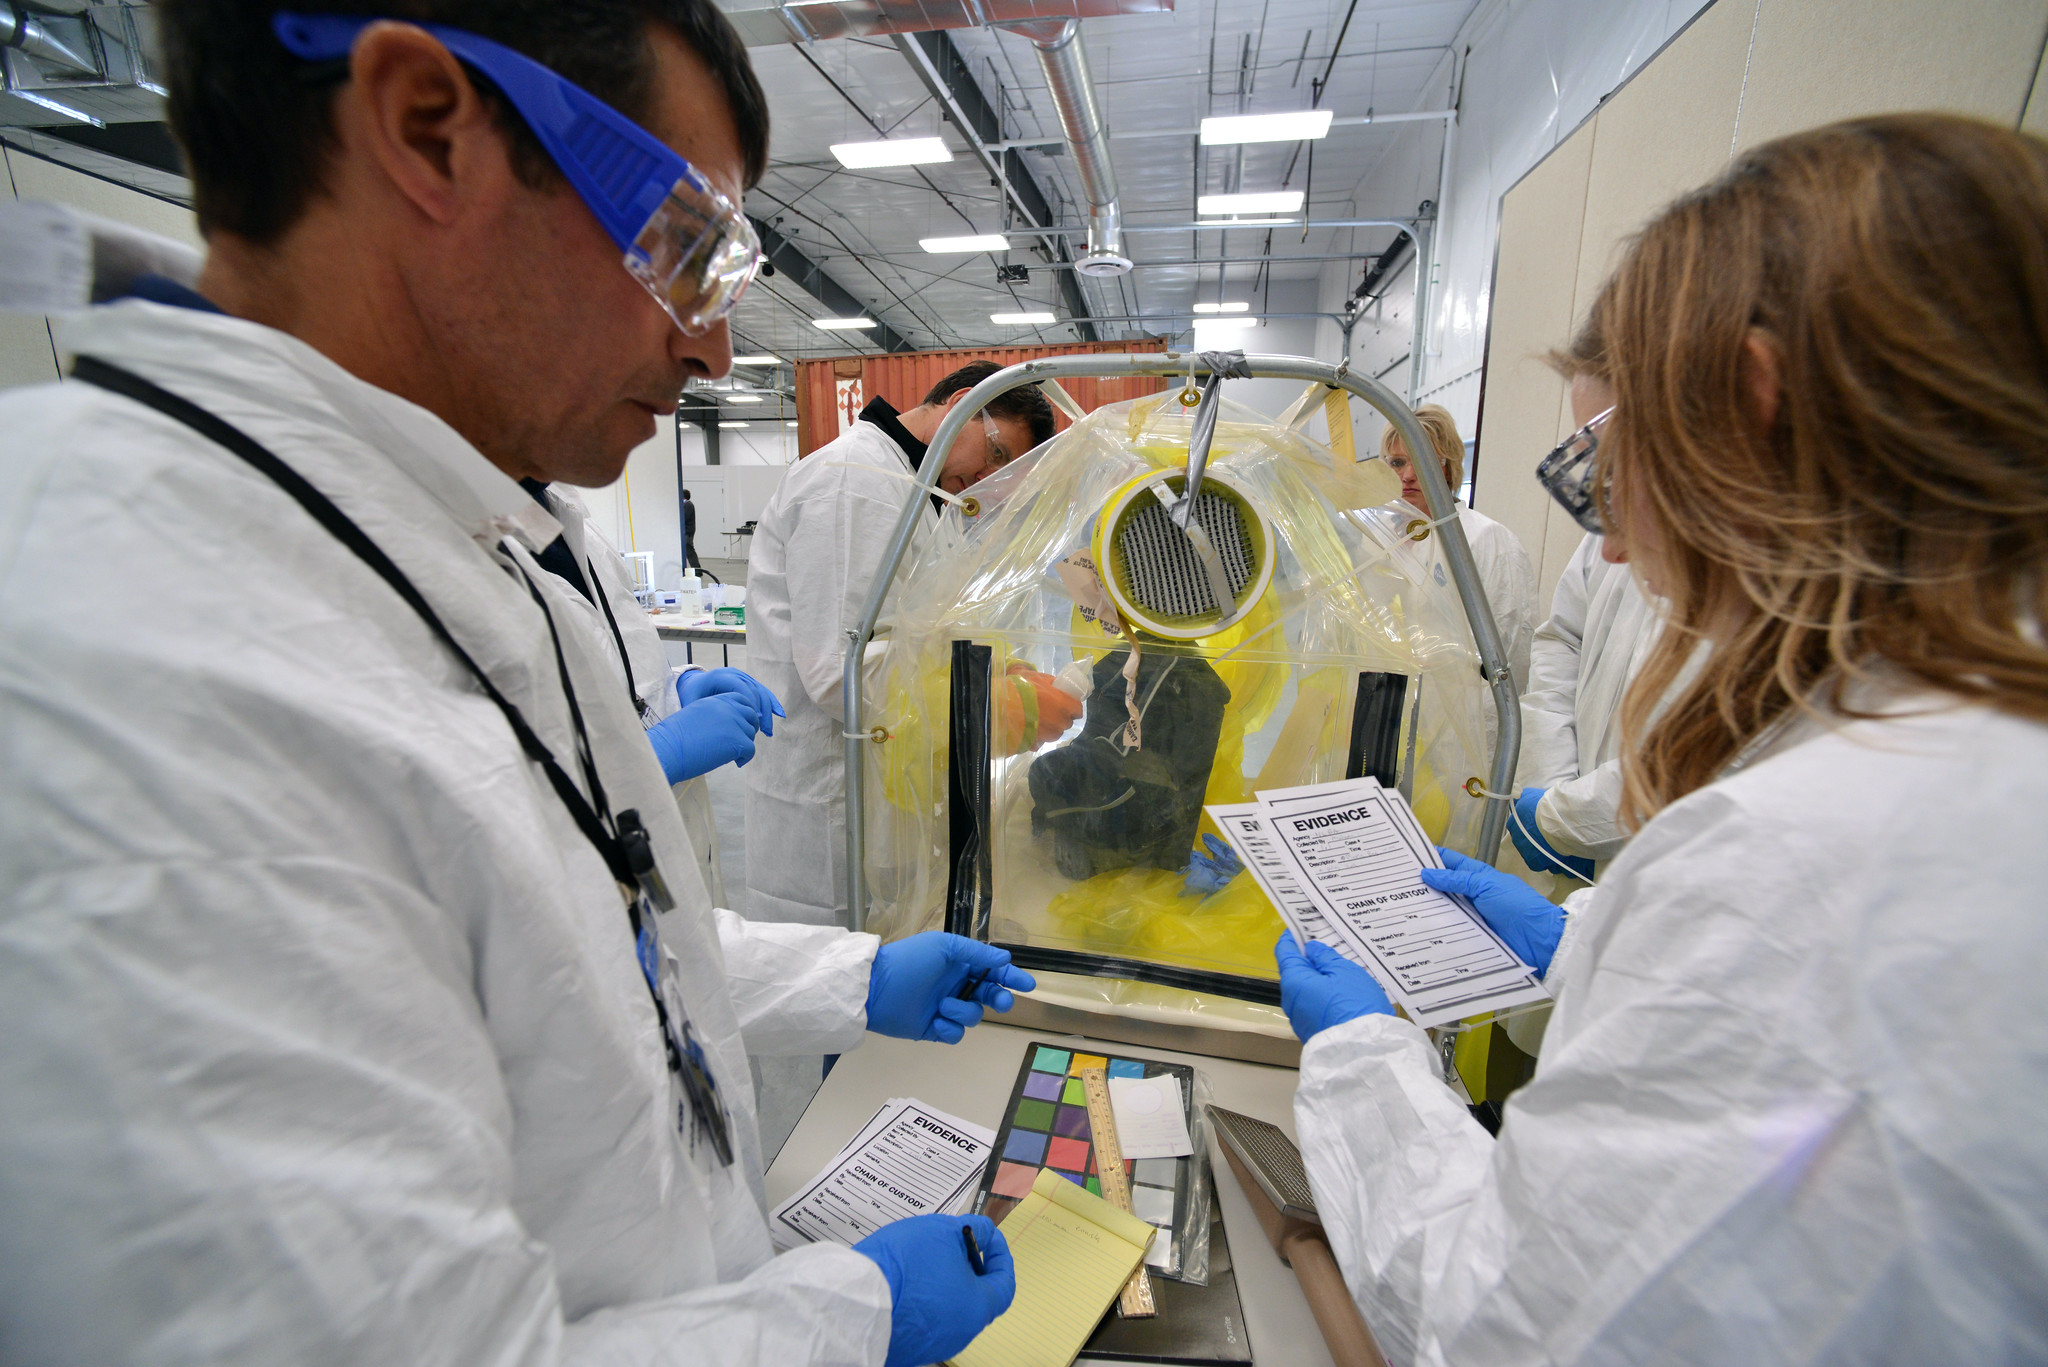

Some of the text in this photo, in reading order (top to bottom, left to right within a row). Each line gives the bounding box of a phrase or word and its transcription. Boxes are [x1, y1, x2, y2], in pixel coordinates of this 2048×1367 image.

[1079, 605, 1095, 616] TAPE
[1293, 807, 1371, 831] EVIDENCE
[1296, 840, 1318, 848] Collected
[1309, 860, 1335, 868] Description
[1347, 888, 1430, 910] CHAIN OF CUSTODY
[1371, 934, 1393, 942] Received
[1395, 963, 1418, 971] Received
[896, 1125, 913, 1136] Collected
[901, 1121, 914, 1130] Agency
[913, 1116, 978, 1153] EVIDENCE
[882, 1136, 903, 1149] Description
[873, 1144, 889, 1155] Location
[926, 1147, 936, 1155] Case
[864, 1152, 880, 1164] Remarks
[845, 1168, 871, 1186] Received from
[854, 1165, 926, 1209] CHAIN OF CUSTODY
[824, 1187, 851, 1206] Received from
[871, 1200, 880, 1209] Time
[790, 1215, 800, 1223] Date
[802, 1206, 828, 1226] Received from
[850, 1221, 860, 1229] Time
